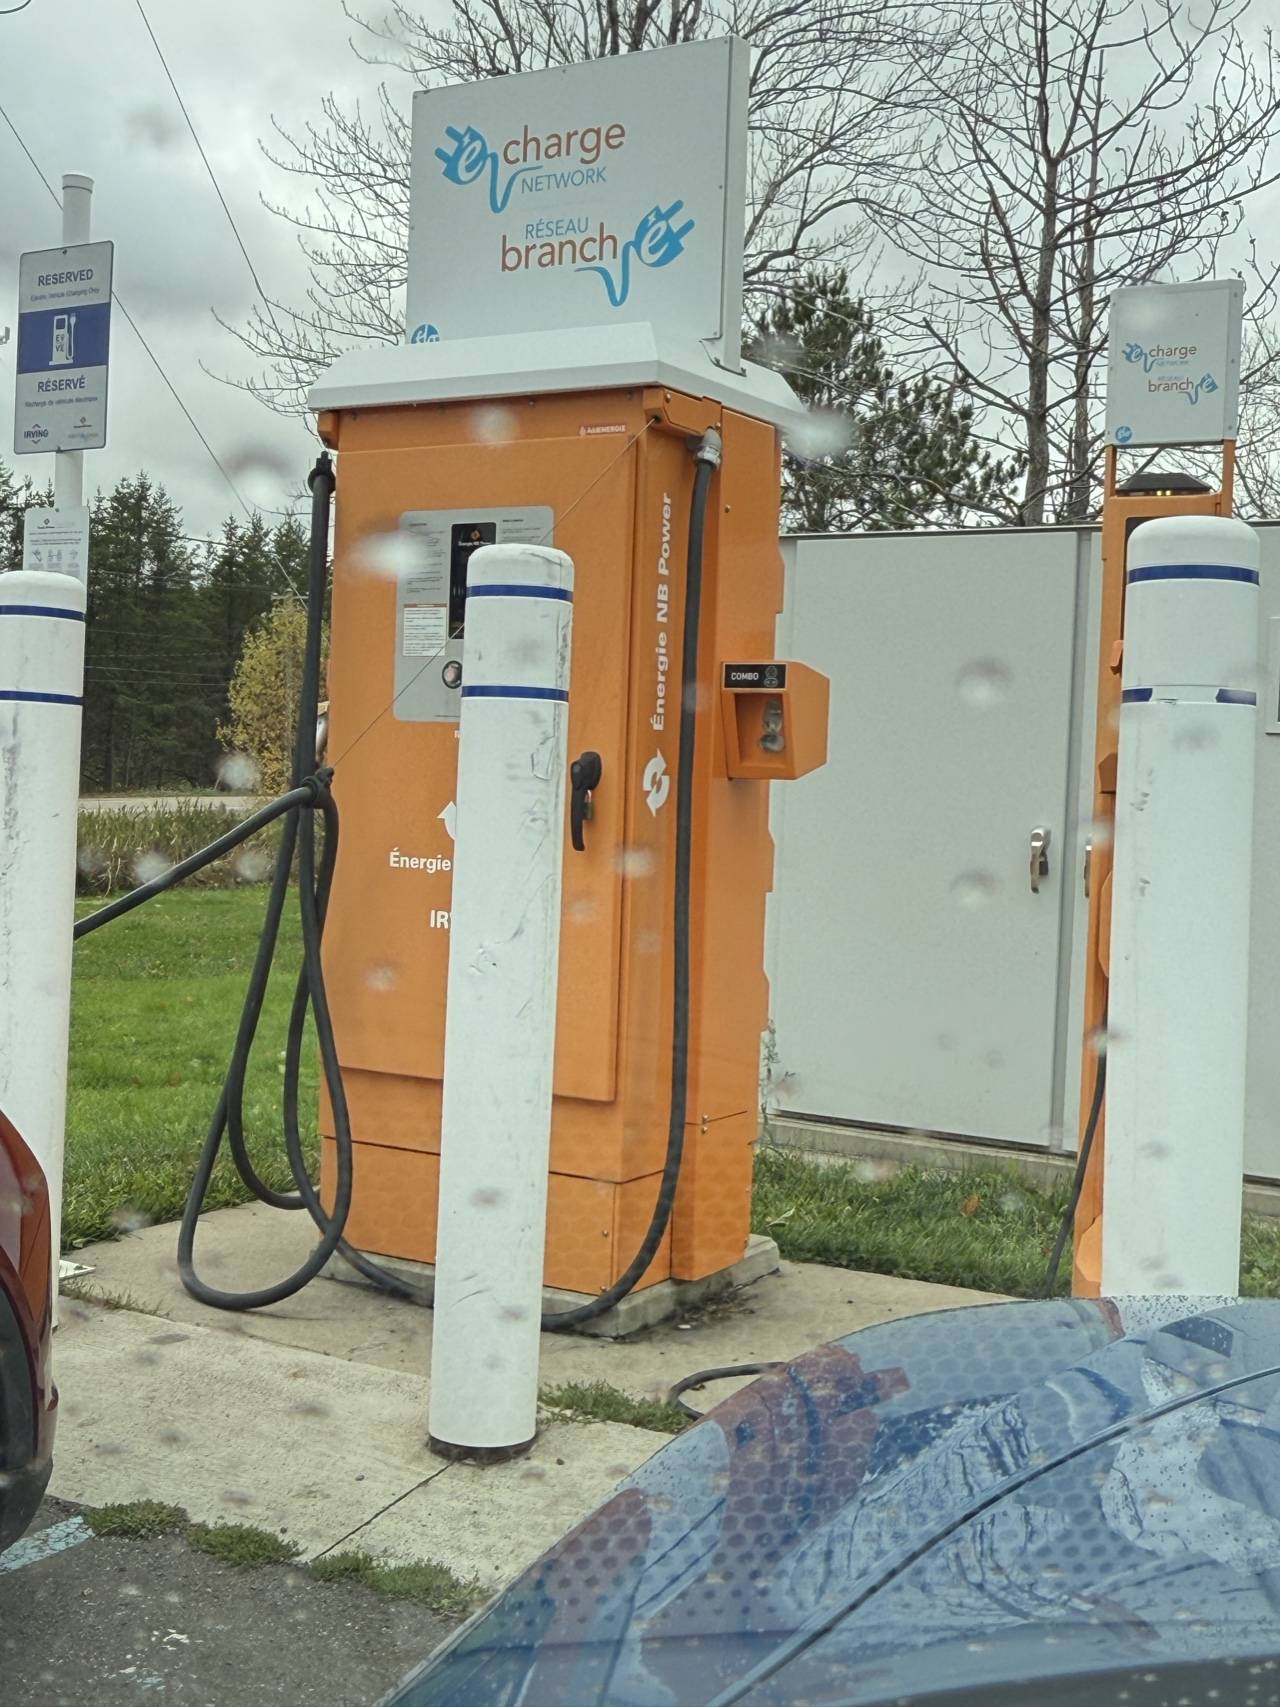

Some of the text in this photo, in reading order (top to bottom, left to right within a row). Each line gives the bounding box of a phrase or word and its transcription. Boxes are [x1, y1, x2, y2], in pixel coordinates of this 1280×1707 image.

[503, 123, 626, 165] charge
[521, 167, 607, 194] NETWORK
[525, 217, 589, 240] RÉSEAU
[501, 223, 618, 272] branch
[38, 268, 94, 287] RESERVED
[1148, 344, 1198, 360] charge
[37, 375, 87, 393] RÉSERVÉ
[1148, 376, 1194, 393] branch
[23, 429, 49, 439] IRVING
[650, 493, 672, 731] Énergie NB Power
[730, 672, 759, 681] COMBO
[389, 848, 452, 874] Énergie
